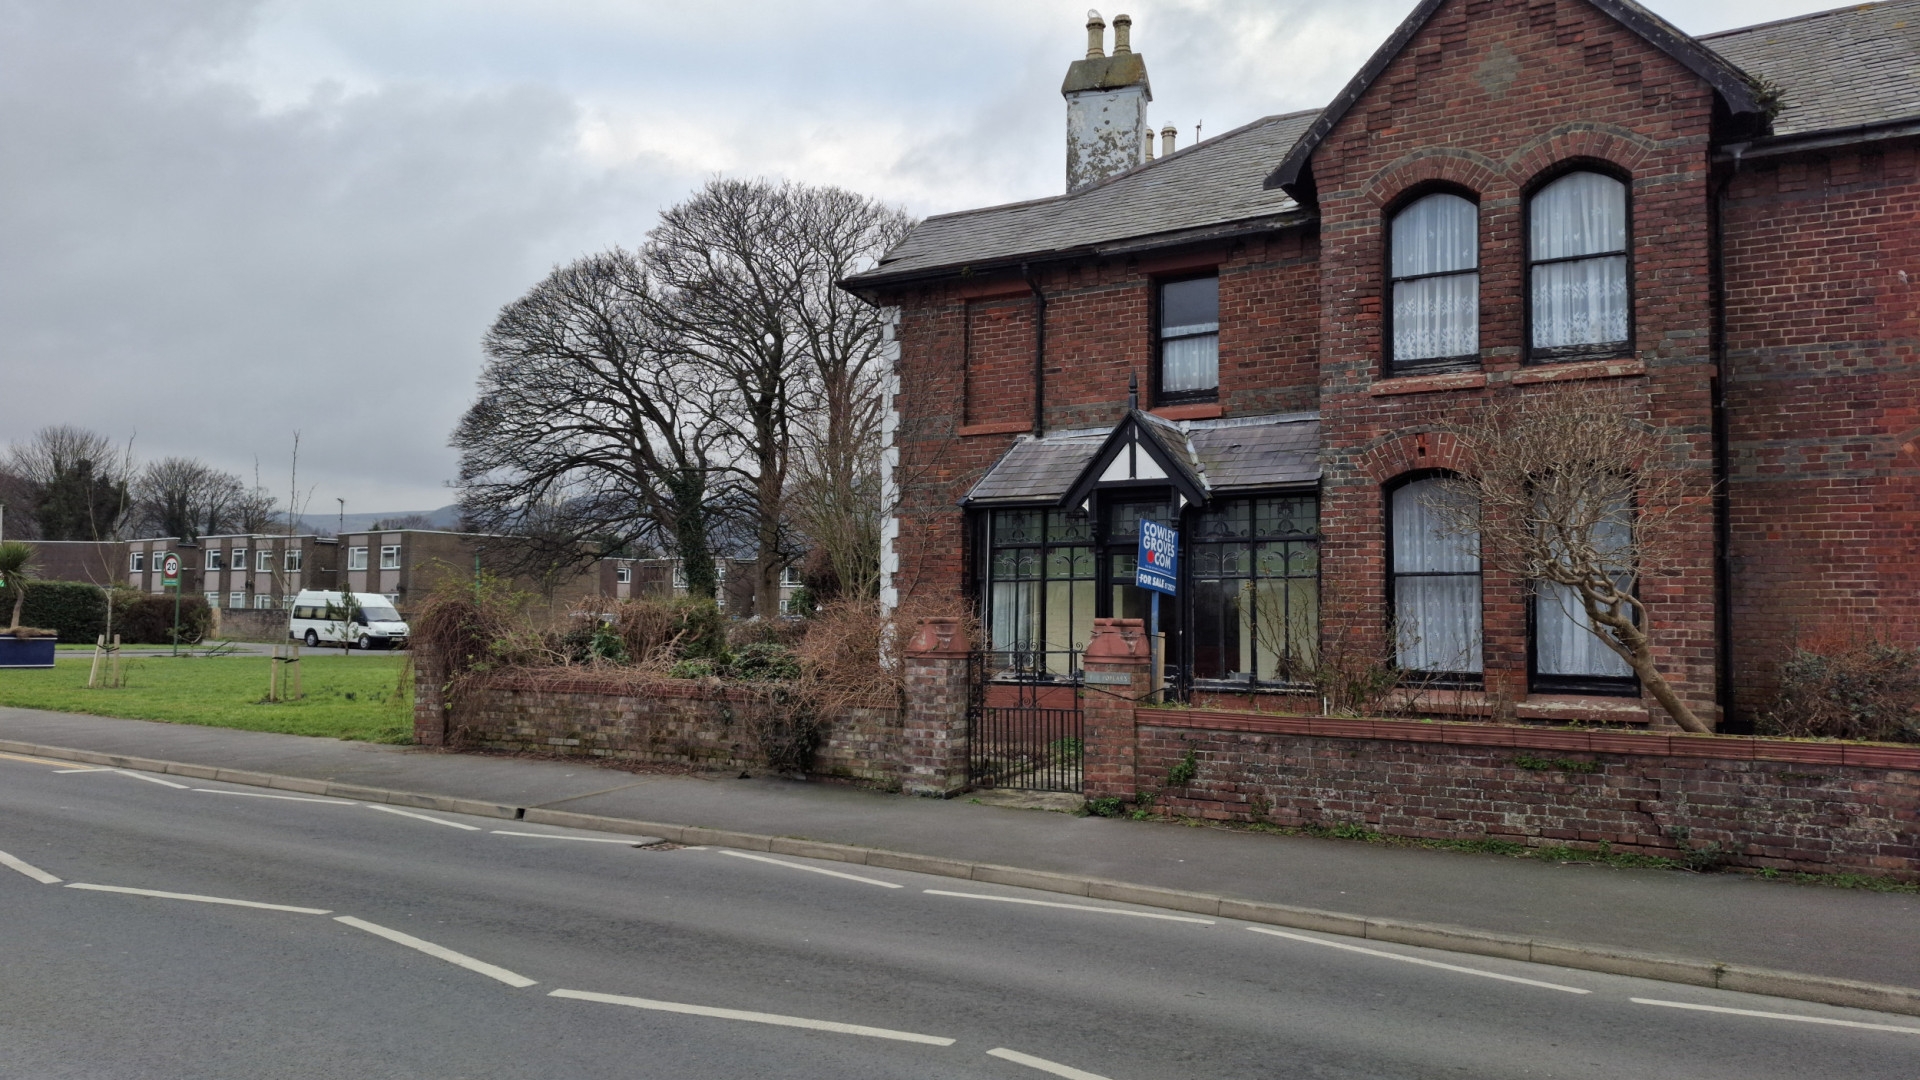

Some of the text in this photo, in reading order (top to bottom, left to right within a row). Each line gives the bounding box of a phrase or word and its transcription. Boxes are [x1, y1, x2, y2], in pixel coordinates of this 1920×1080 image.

[1144, 522, 1175, 544] COWLEY
[1143, 535, 1175, 557] GROVES
[166, 562, 177, 571] 20
[1139, 573, 1152, 585] FOR
[1152, 576, 1165, 589] SALE
